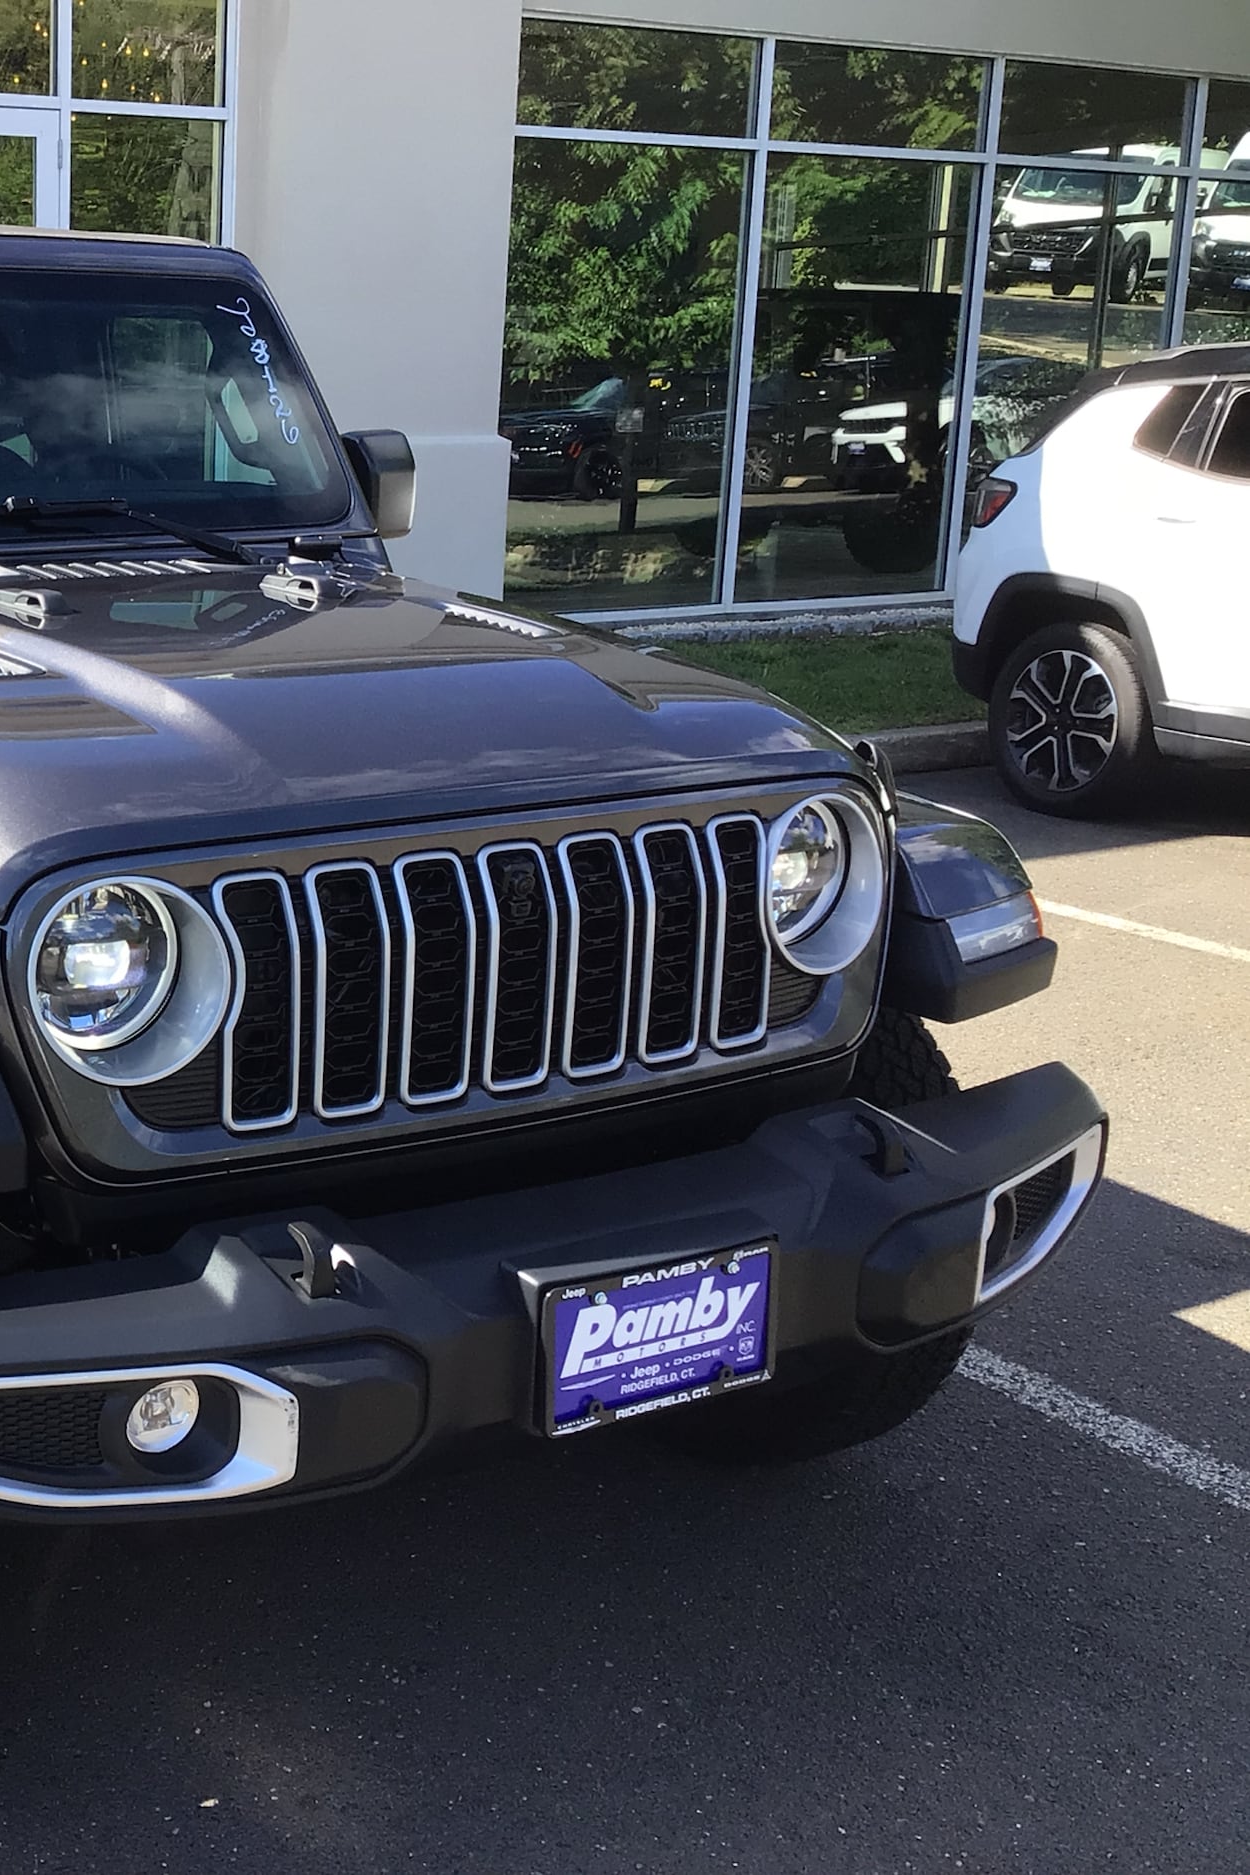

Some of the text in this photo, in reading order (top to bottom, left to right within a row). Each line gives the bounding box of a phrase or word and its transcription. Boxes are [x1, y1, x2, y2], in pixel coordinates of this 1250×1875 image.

[621, 1256, 715, 1289] PAMBY
[561, 1287, 587, 1300] Jeep
[559, 1275, 761, 1379] Pamby
[593, 1330, 707, 1369] MOTORS
[629, 1348, 721, 1380] Jeep DODGE
[620, 1367, 696, 1395] RIDGEFIELD, CT.
[615, 1386, 711, 1420] RIDGEFIELD, CT.
